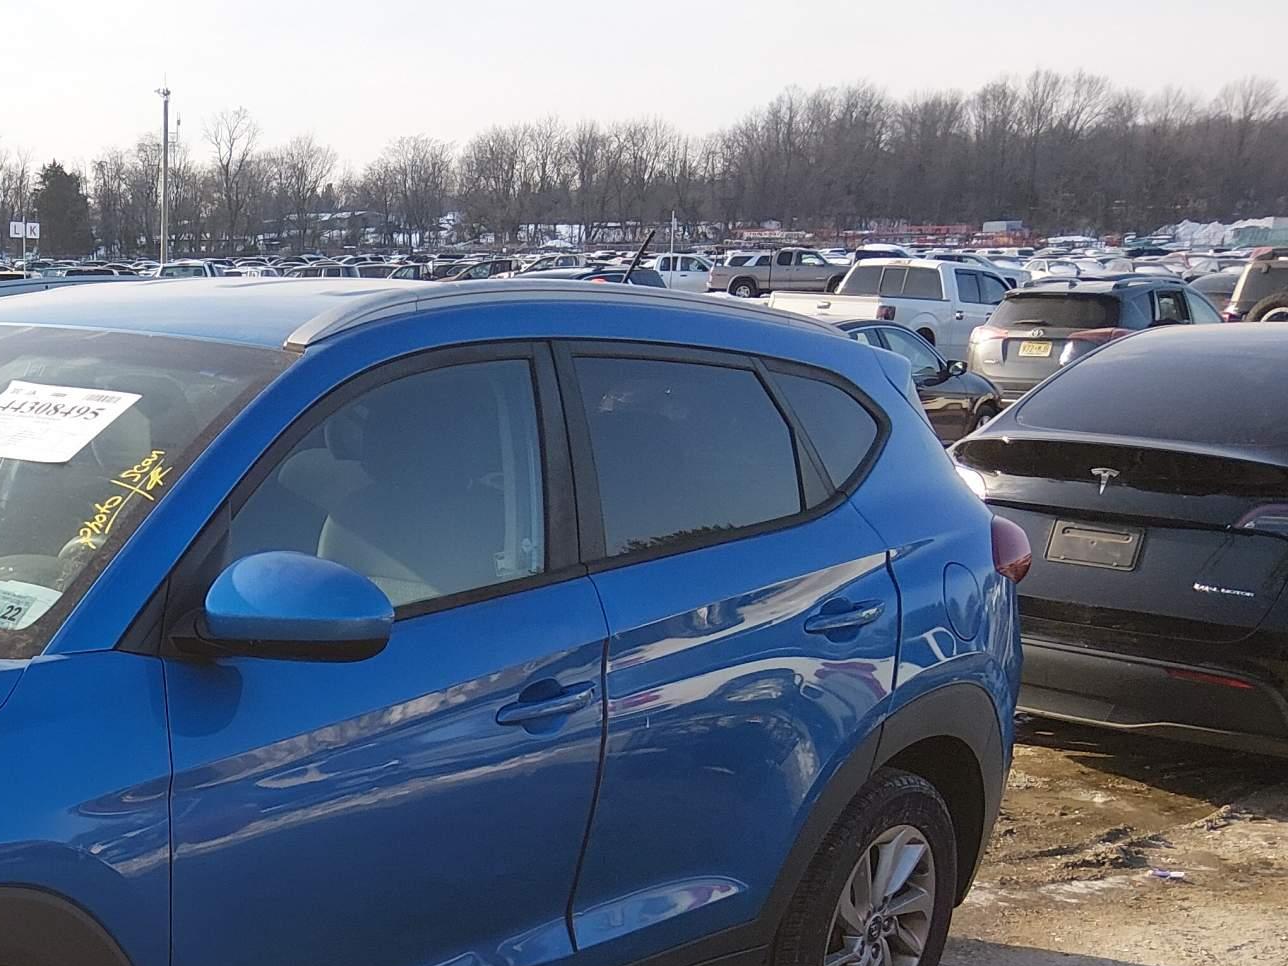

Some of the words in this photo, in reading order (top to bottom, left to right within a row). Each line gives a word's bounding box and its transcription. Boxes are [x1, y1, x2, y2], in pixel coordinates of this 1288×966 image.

[29, 225, 37, 236] K
[0, 400, 106, 421] 44308495
[0, 605, 22, 622] 22
